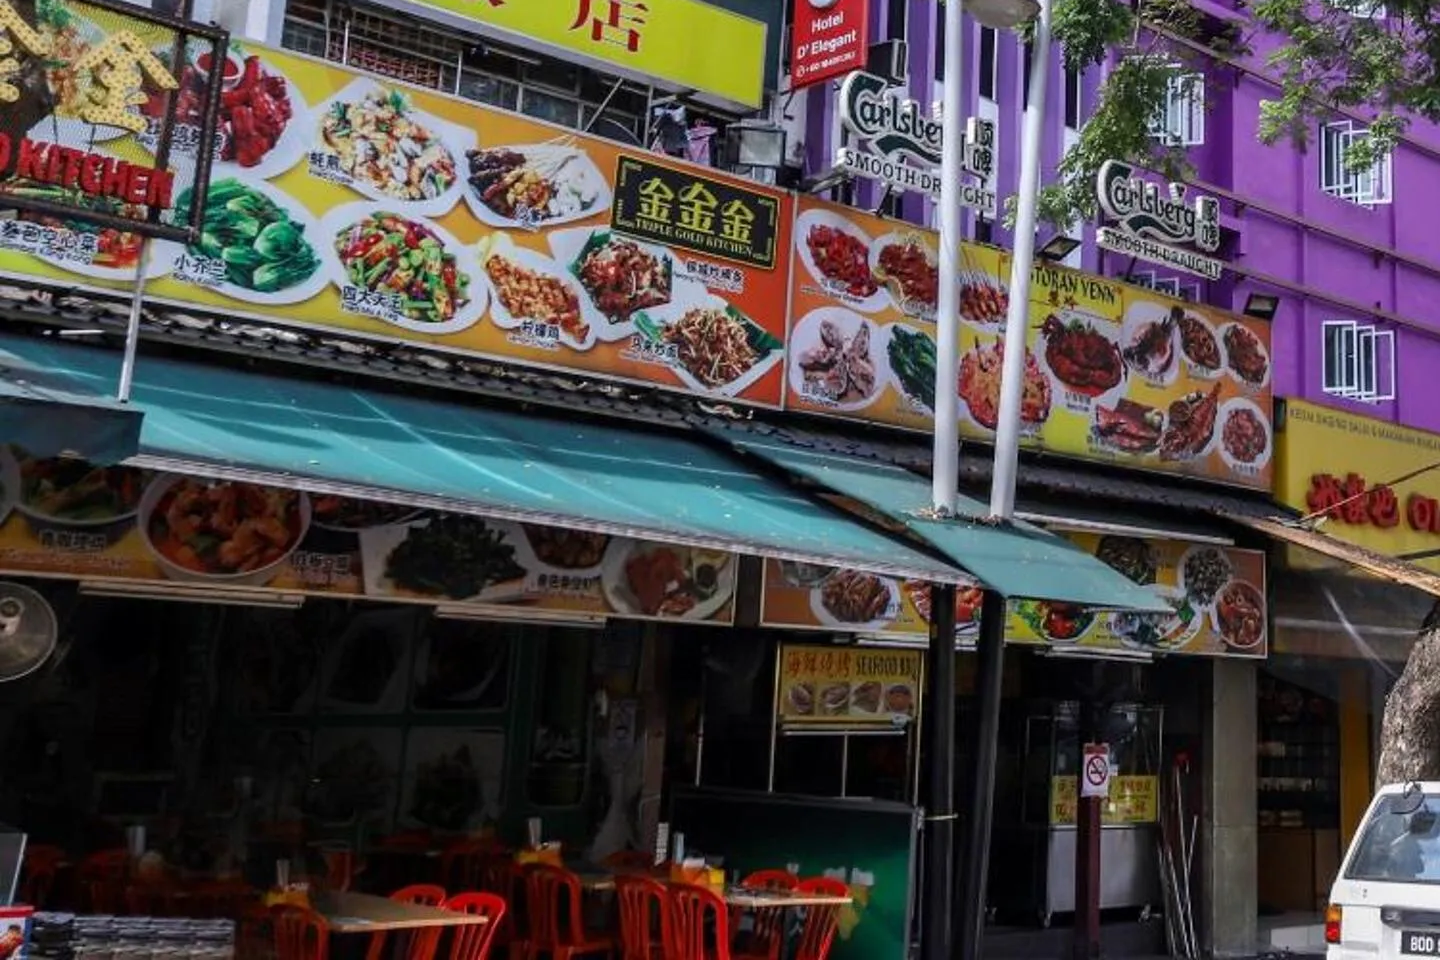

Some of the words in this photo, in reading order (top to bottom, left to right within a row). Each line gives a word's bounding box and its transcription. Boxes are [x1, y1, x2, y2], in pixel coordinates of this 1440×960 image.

[812, 11, 843, 33] Hotel
[812, 29, 856, 54] Elegant
[849, 75, 965, 157] Carlsbe
[17, 136, 175, 209] KITCHEN
[846, 151, 916, 185] SMOOTH
[921, 174, 995, 208] DRGHT
[1105, 161, 1196, 238] Carlsberg
[636, 218, 672, 237] TRIPLE
[675, 229, 702, 244] GOLD
[706, 235, 753, 255] KITCHEN
[637, 177, 755, 244] 金金金
[1031, 267, 1078, 293] TORAN
